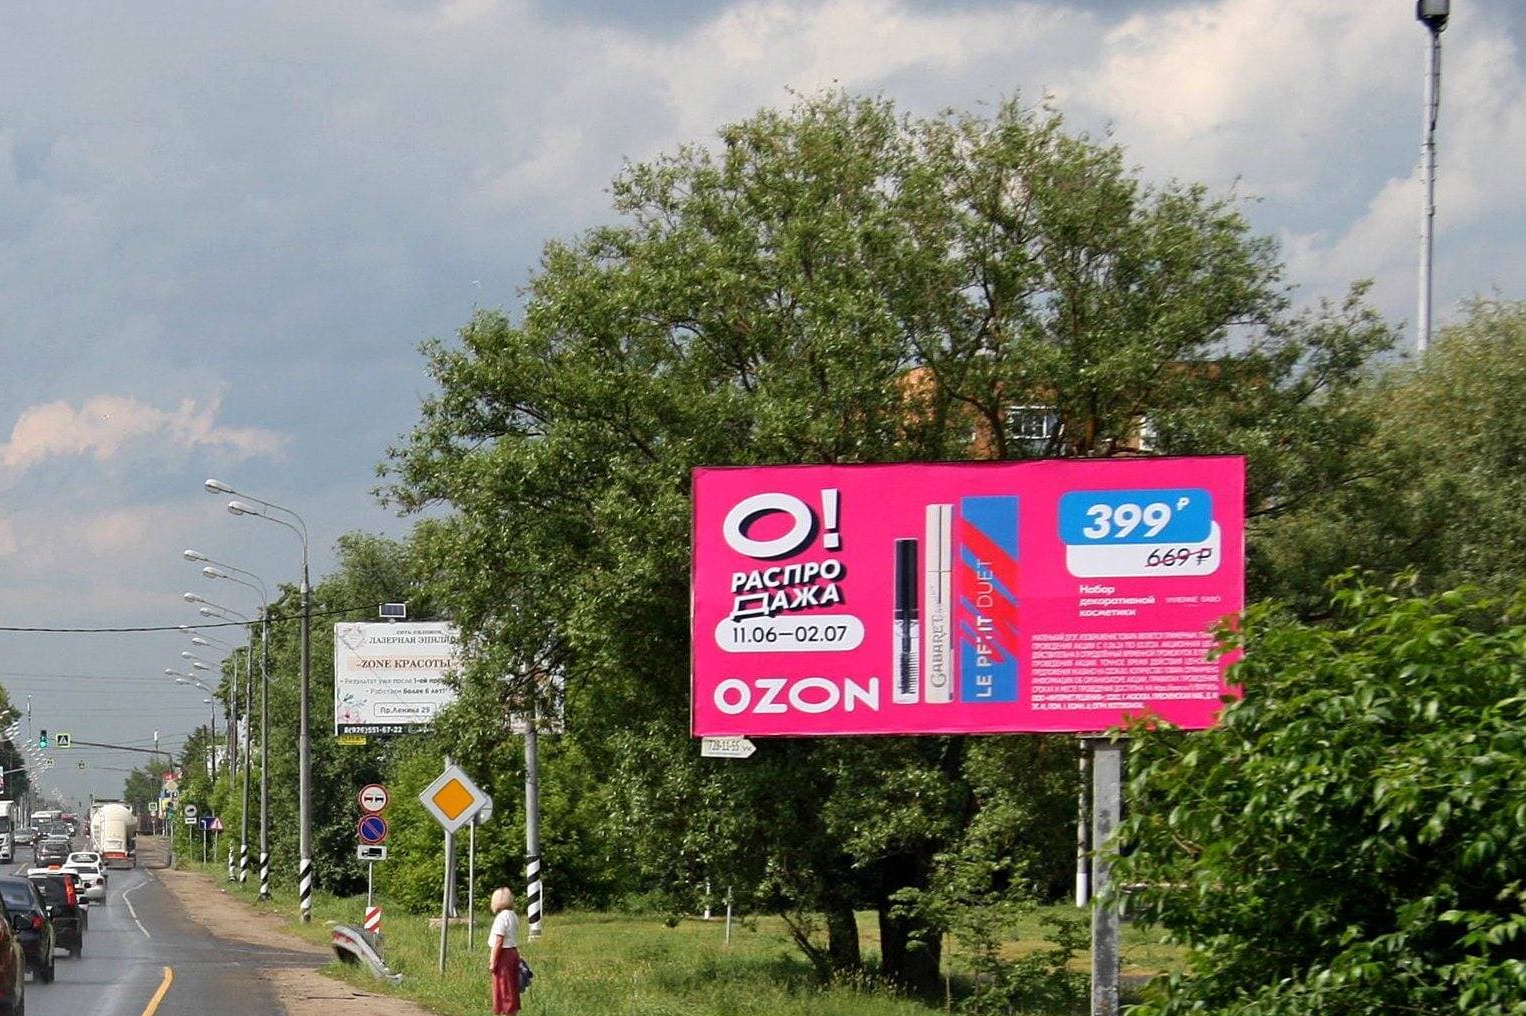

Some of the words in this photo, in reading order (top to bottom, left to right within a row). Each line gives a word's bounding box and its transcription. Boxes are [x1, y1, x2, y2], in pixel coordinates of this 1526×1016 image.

[723, 488, 840, 558] О!
[1146, 548, 1190, 567] 669
[731, 558, 842, 593] РАСПРО
[976, 558, 993, 608] DUET
[730, 582, 840, 618] ДАЖА
[369, 636, 416, 644] ЛАЗЕРНАЯ
[714, 677, 880, 714] OZON
[976, 674, 992, 698] LE
